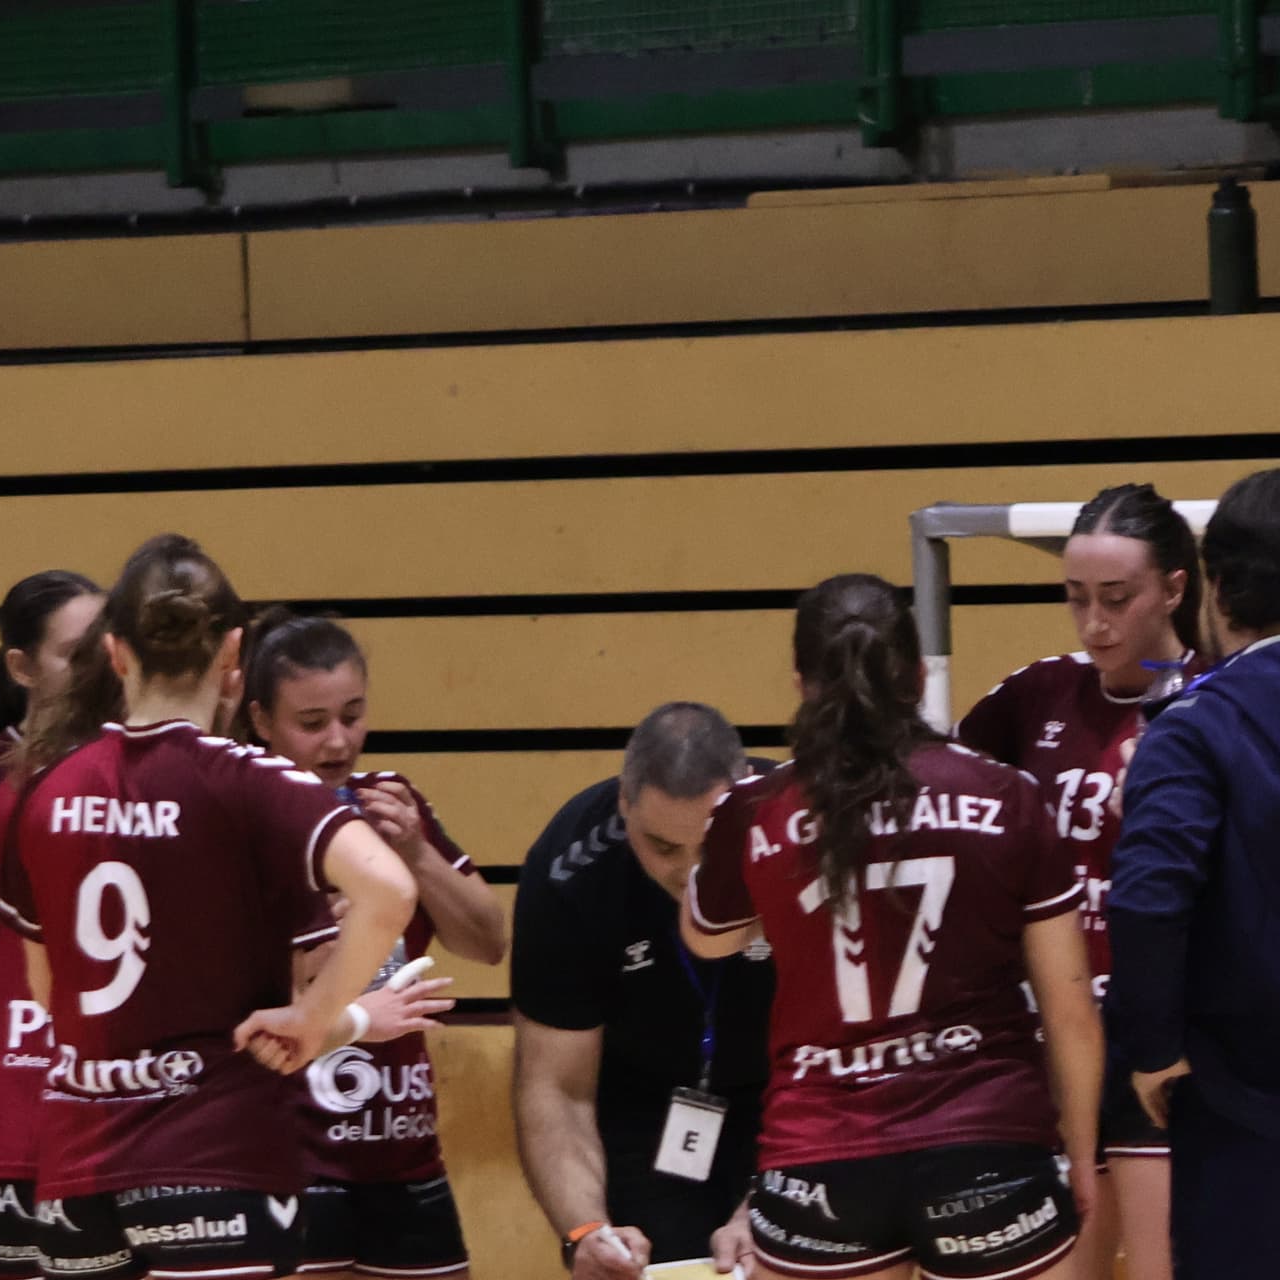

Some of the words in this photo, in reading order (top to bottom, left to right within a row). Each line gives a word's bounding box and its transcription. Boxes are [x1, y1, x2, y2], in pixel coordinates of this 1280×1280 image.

[50, 796, 181, 838] HENAR
[1056, 768, 1115, 841] 13
[75, 860, 152, 1017] 9
[797, 856, 956, 1024] 17
[681, 1129, 700, 1153] E
[935, 1195, 1059, 1256] Dissalud
